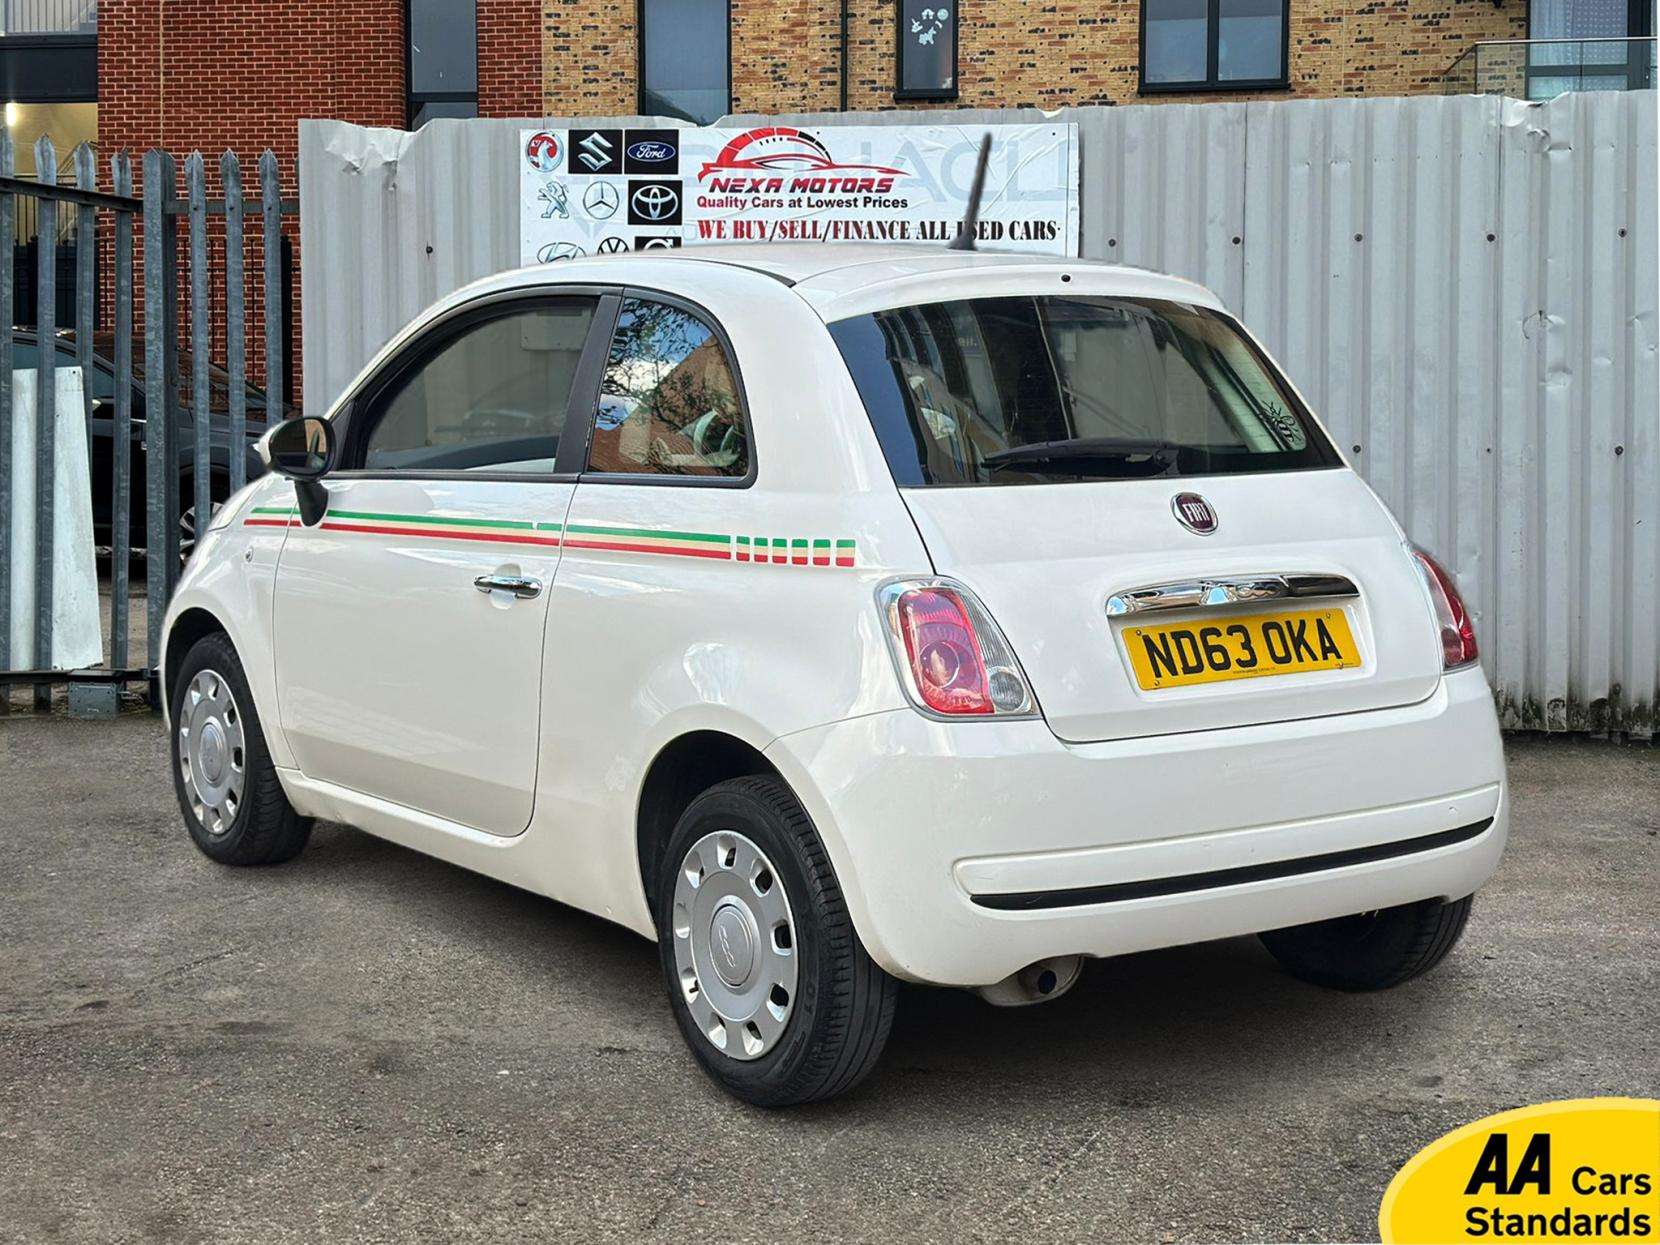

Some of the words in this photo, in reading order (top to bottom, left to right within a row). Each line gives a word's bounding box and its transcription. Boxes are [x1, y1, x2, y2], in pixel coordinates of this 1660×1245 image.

[636, 144, 666, 159] Ford
[708, 178, 784, 194] NEXA
[789, 178, 895, 194] MOTORS
[697, 196, 747, 208] Quality
[752, 196, 784, 208] Cars
[788, 196, 802, 208] at
[807, 196, 859, 208] Lowest
[863, 196, 909, 208] Prices
[697, 220, 727, 240] WE
[733, 219, 910, 243] BUY/SELL/FINANCE
[916, 220, 950, 240] ALL
[1009, 220, 1057, 240] CARS
[1182, 502, 1211, 522] FIAT
[1141, 624, 1258, 678] ND63
[1262, 618, 1343, 665] OKA
